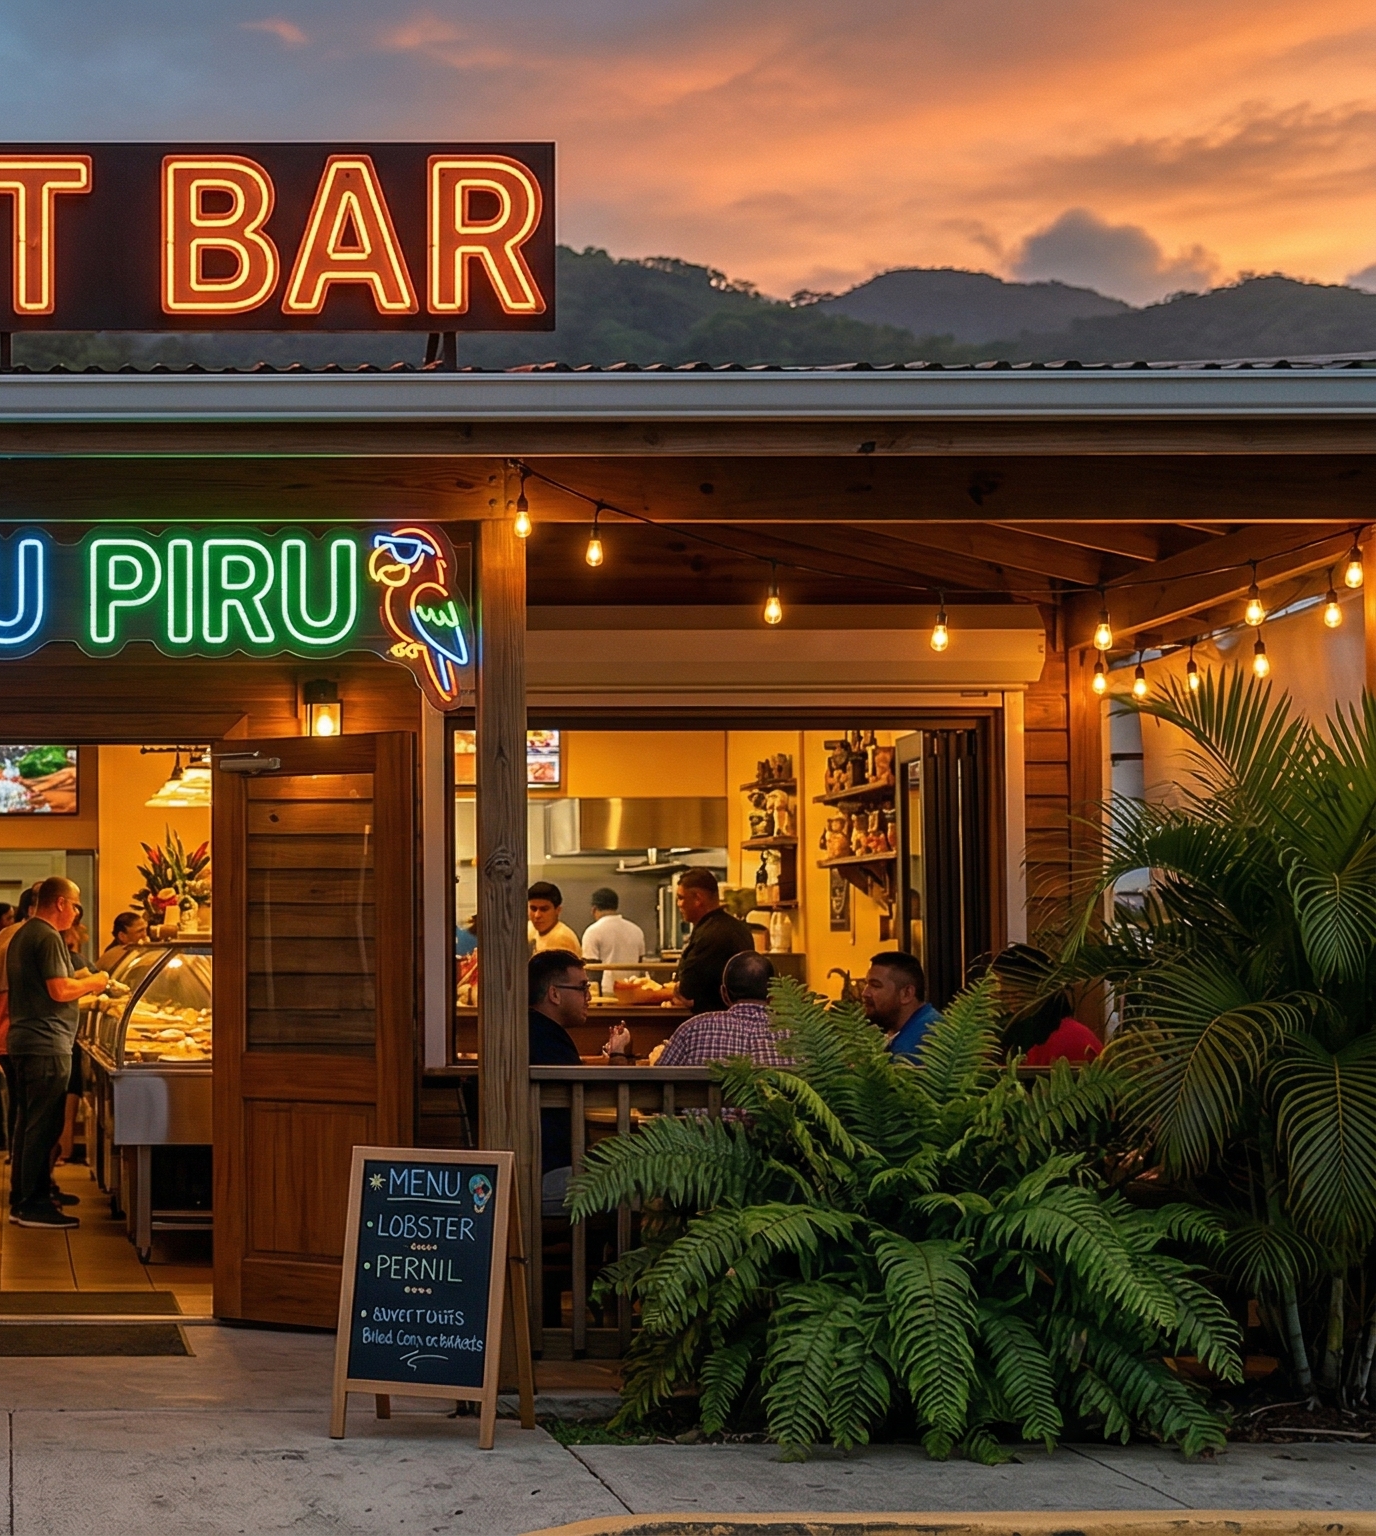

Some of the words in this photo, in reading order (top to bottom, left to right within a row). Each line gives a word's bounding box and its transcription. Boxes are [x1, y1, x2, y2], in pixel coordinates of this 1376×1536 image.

[160, 154, 548, 317] BAR
[88, 537, 359, 645] PIRU
[389, 1168, 461, 1198] MENU
[377, 1213, 475, 1242] LOBSTER
[376, 1254, 463, 1282] PERNIL
